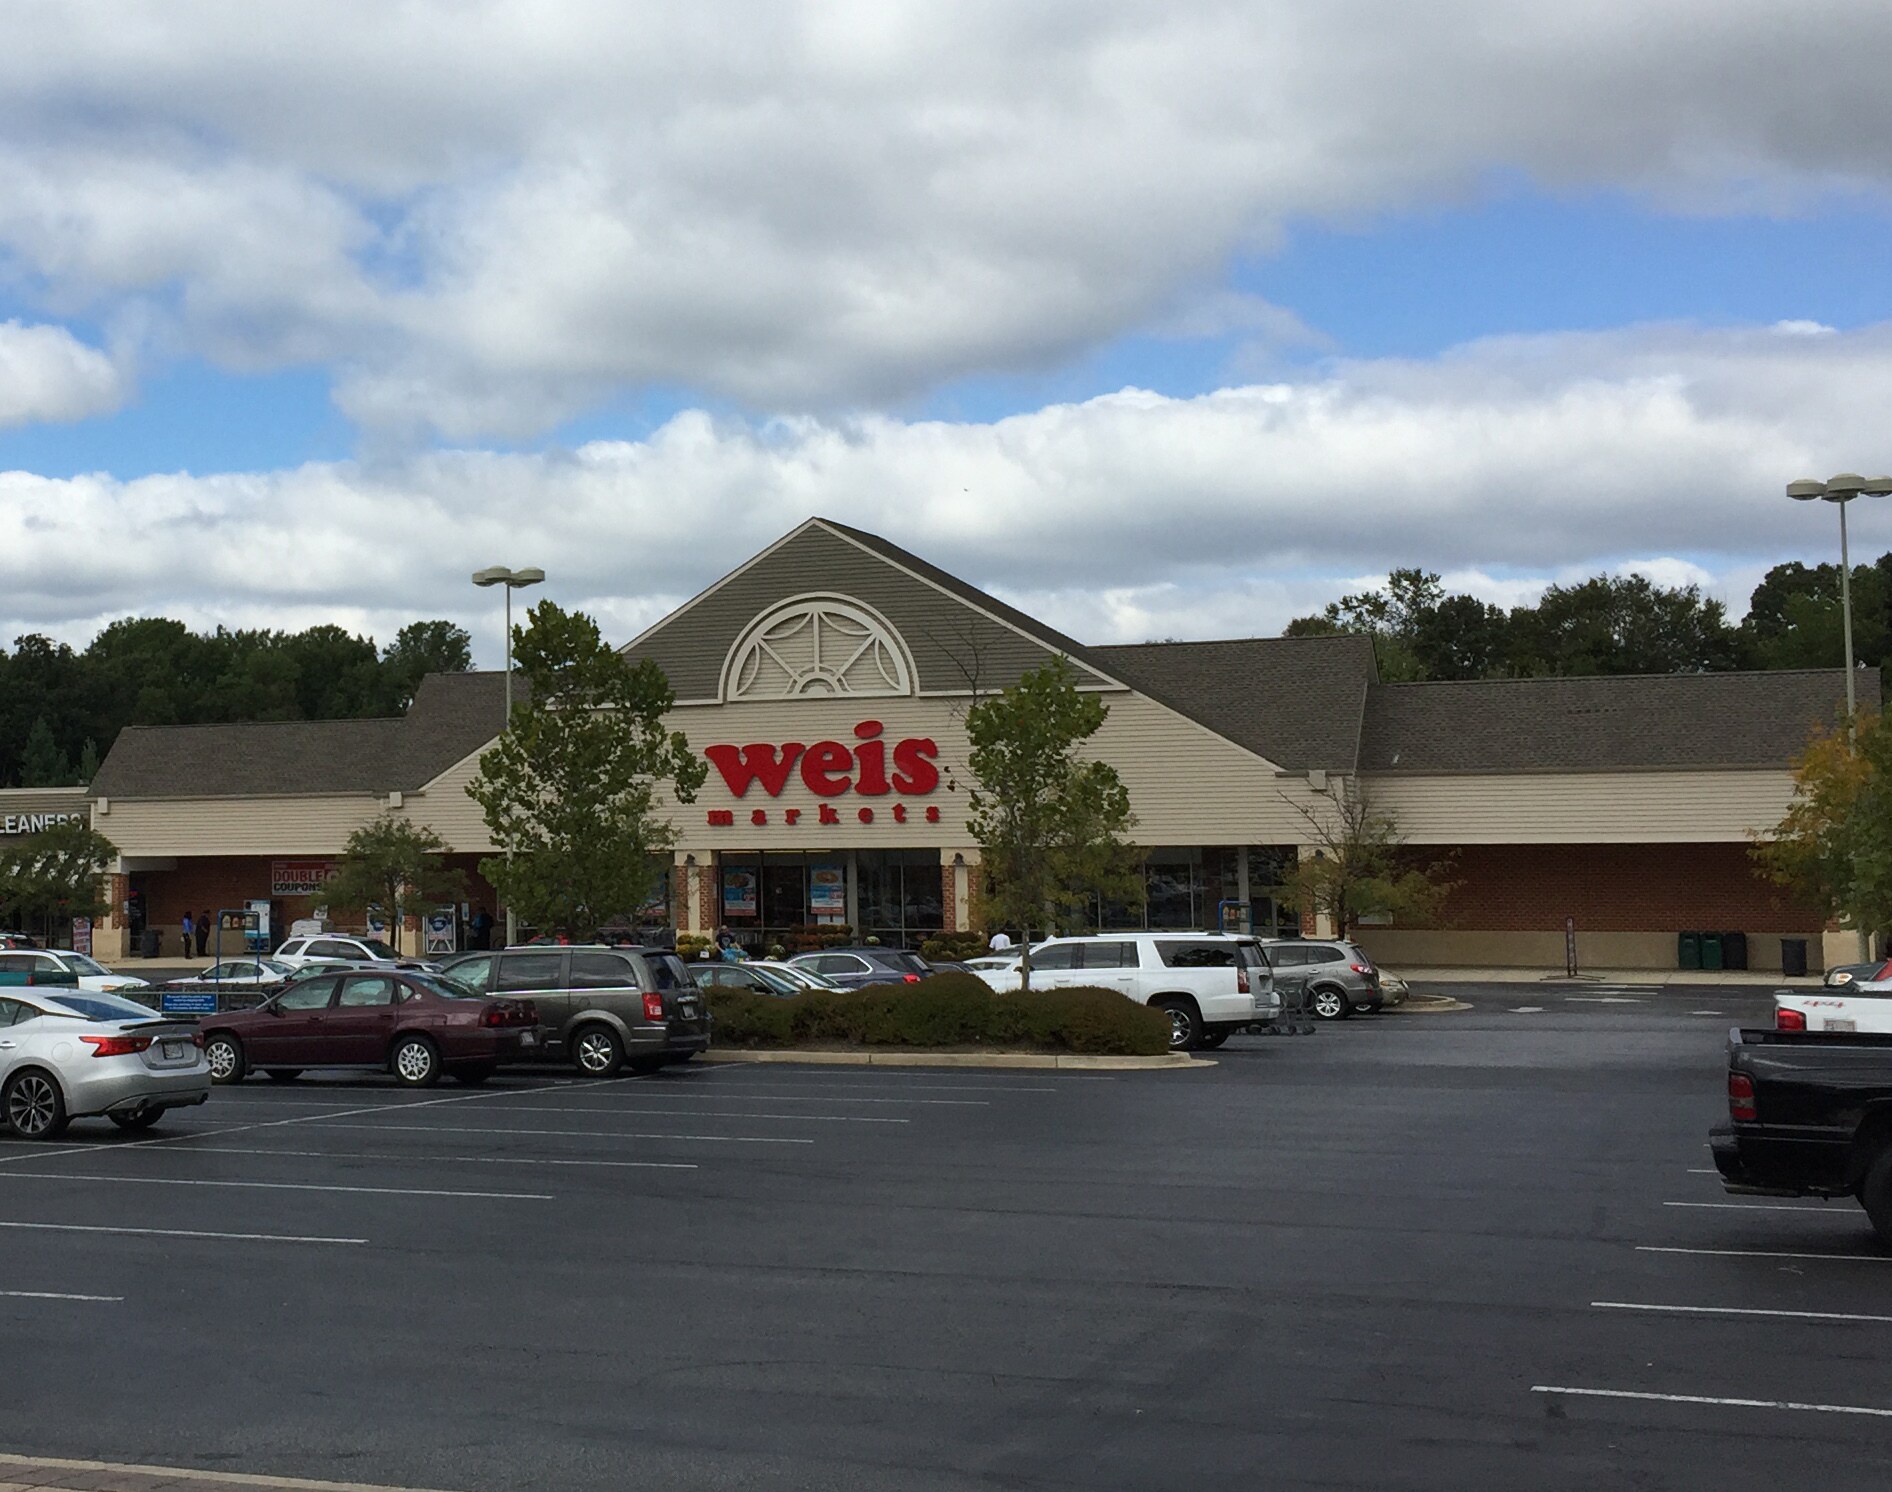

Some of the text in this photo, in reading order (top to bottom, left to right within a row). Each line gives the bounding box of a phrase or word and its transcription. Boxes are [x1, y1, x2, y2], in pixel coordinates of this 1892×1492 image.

[704, 720, 939, 798] weis
[0, 813, 83, 834] EANERS
[707, 803, 940, 826] markets
[273, 870, 325, 882] DOUBLE
[273, 882, 323, 892] COUPONS
